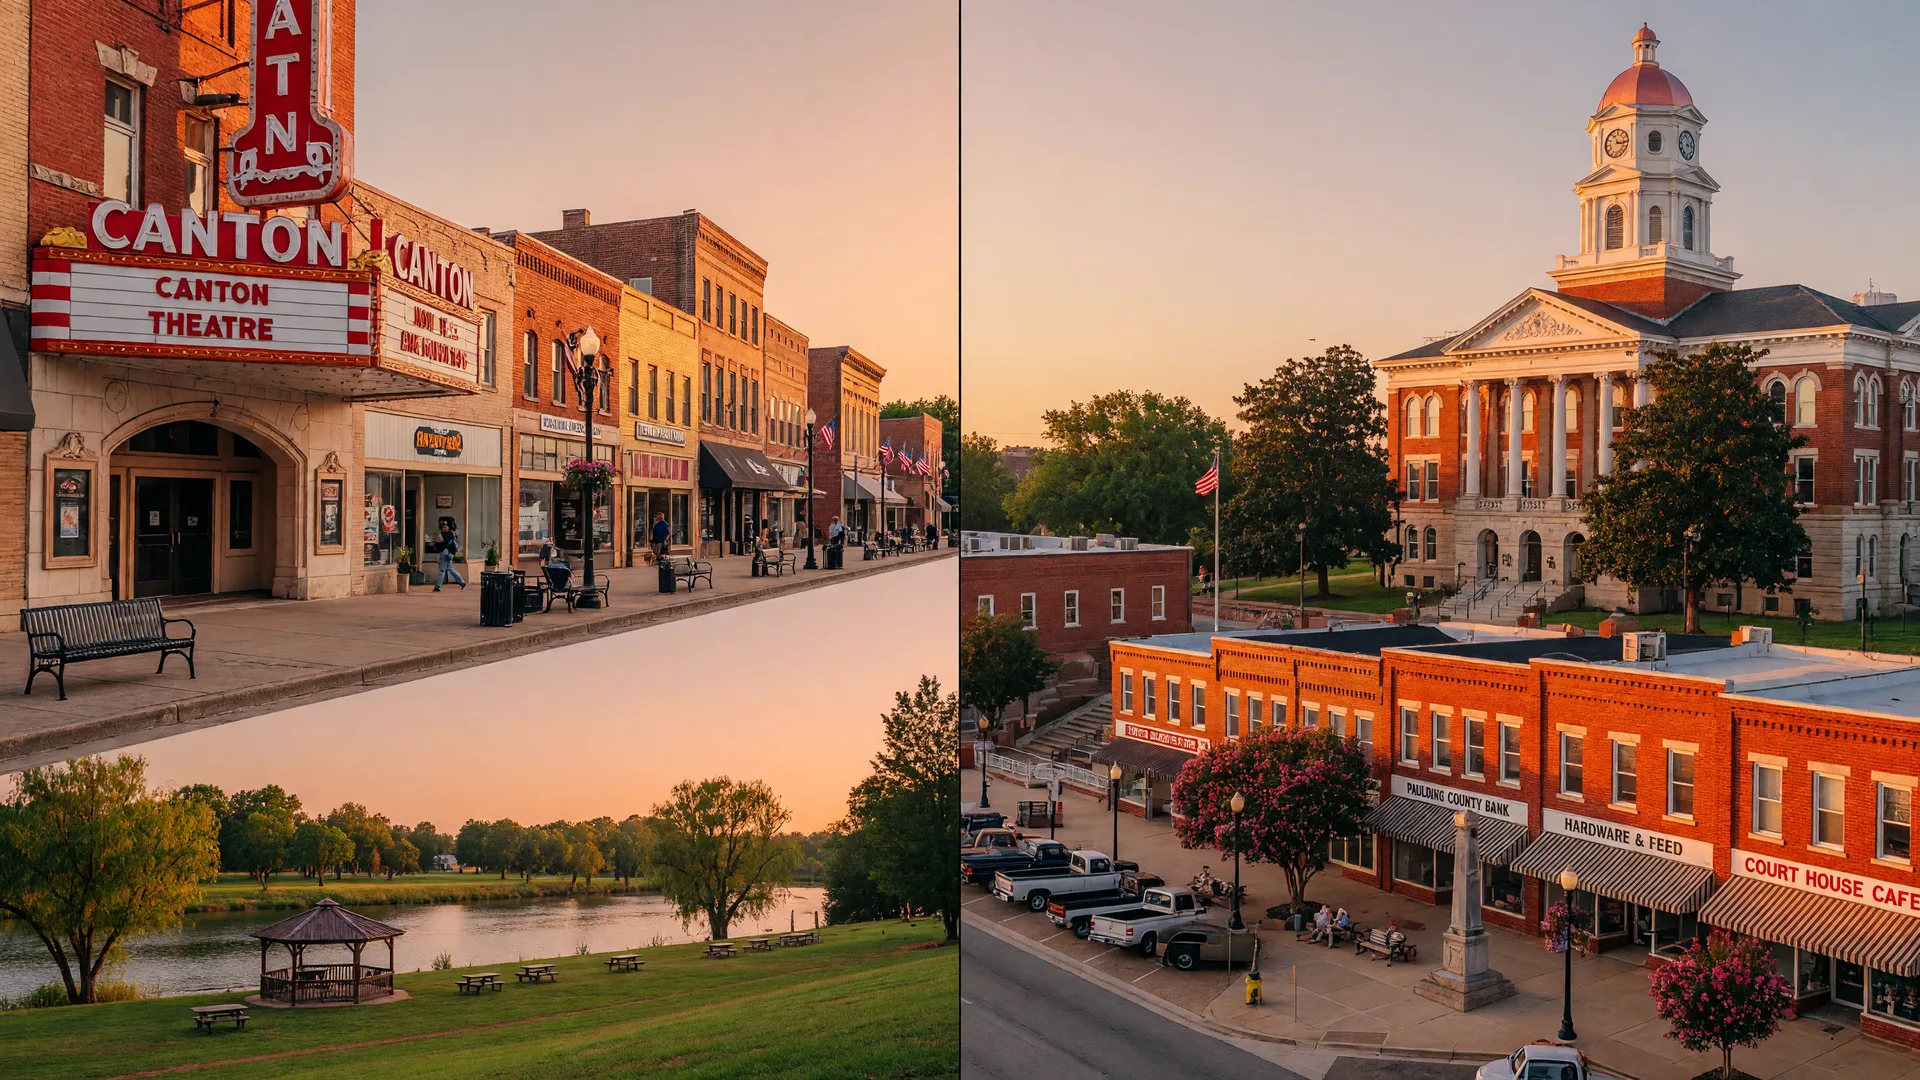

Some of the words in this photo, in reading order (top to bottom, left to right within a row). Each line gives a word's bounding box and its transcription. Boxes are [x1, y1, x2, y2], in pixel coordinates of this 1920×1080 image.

[91, 199, 342, 267] CANTON
[155, 276, 269, 306] CANTON
[394, 234, 474, 311] CANTON
[148, 310, 274, 341] THEATRE
[1407, 782, 1444, 802] PAULDING
[1447, 791, 1482, 811] COUNTY
[1485, 798, 1510, 817] BANK
[1564, 817, 1630, 843] HARDWARE
[1635, 833, 1645, 847] &
[1649, 836, 1683, 856] FEED
[1744, 857, 1799, 883] COURT
[1805, 869, 1864, 898] HOUSE
[1872, 885, 1920, 911] CAFE
